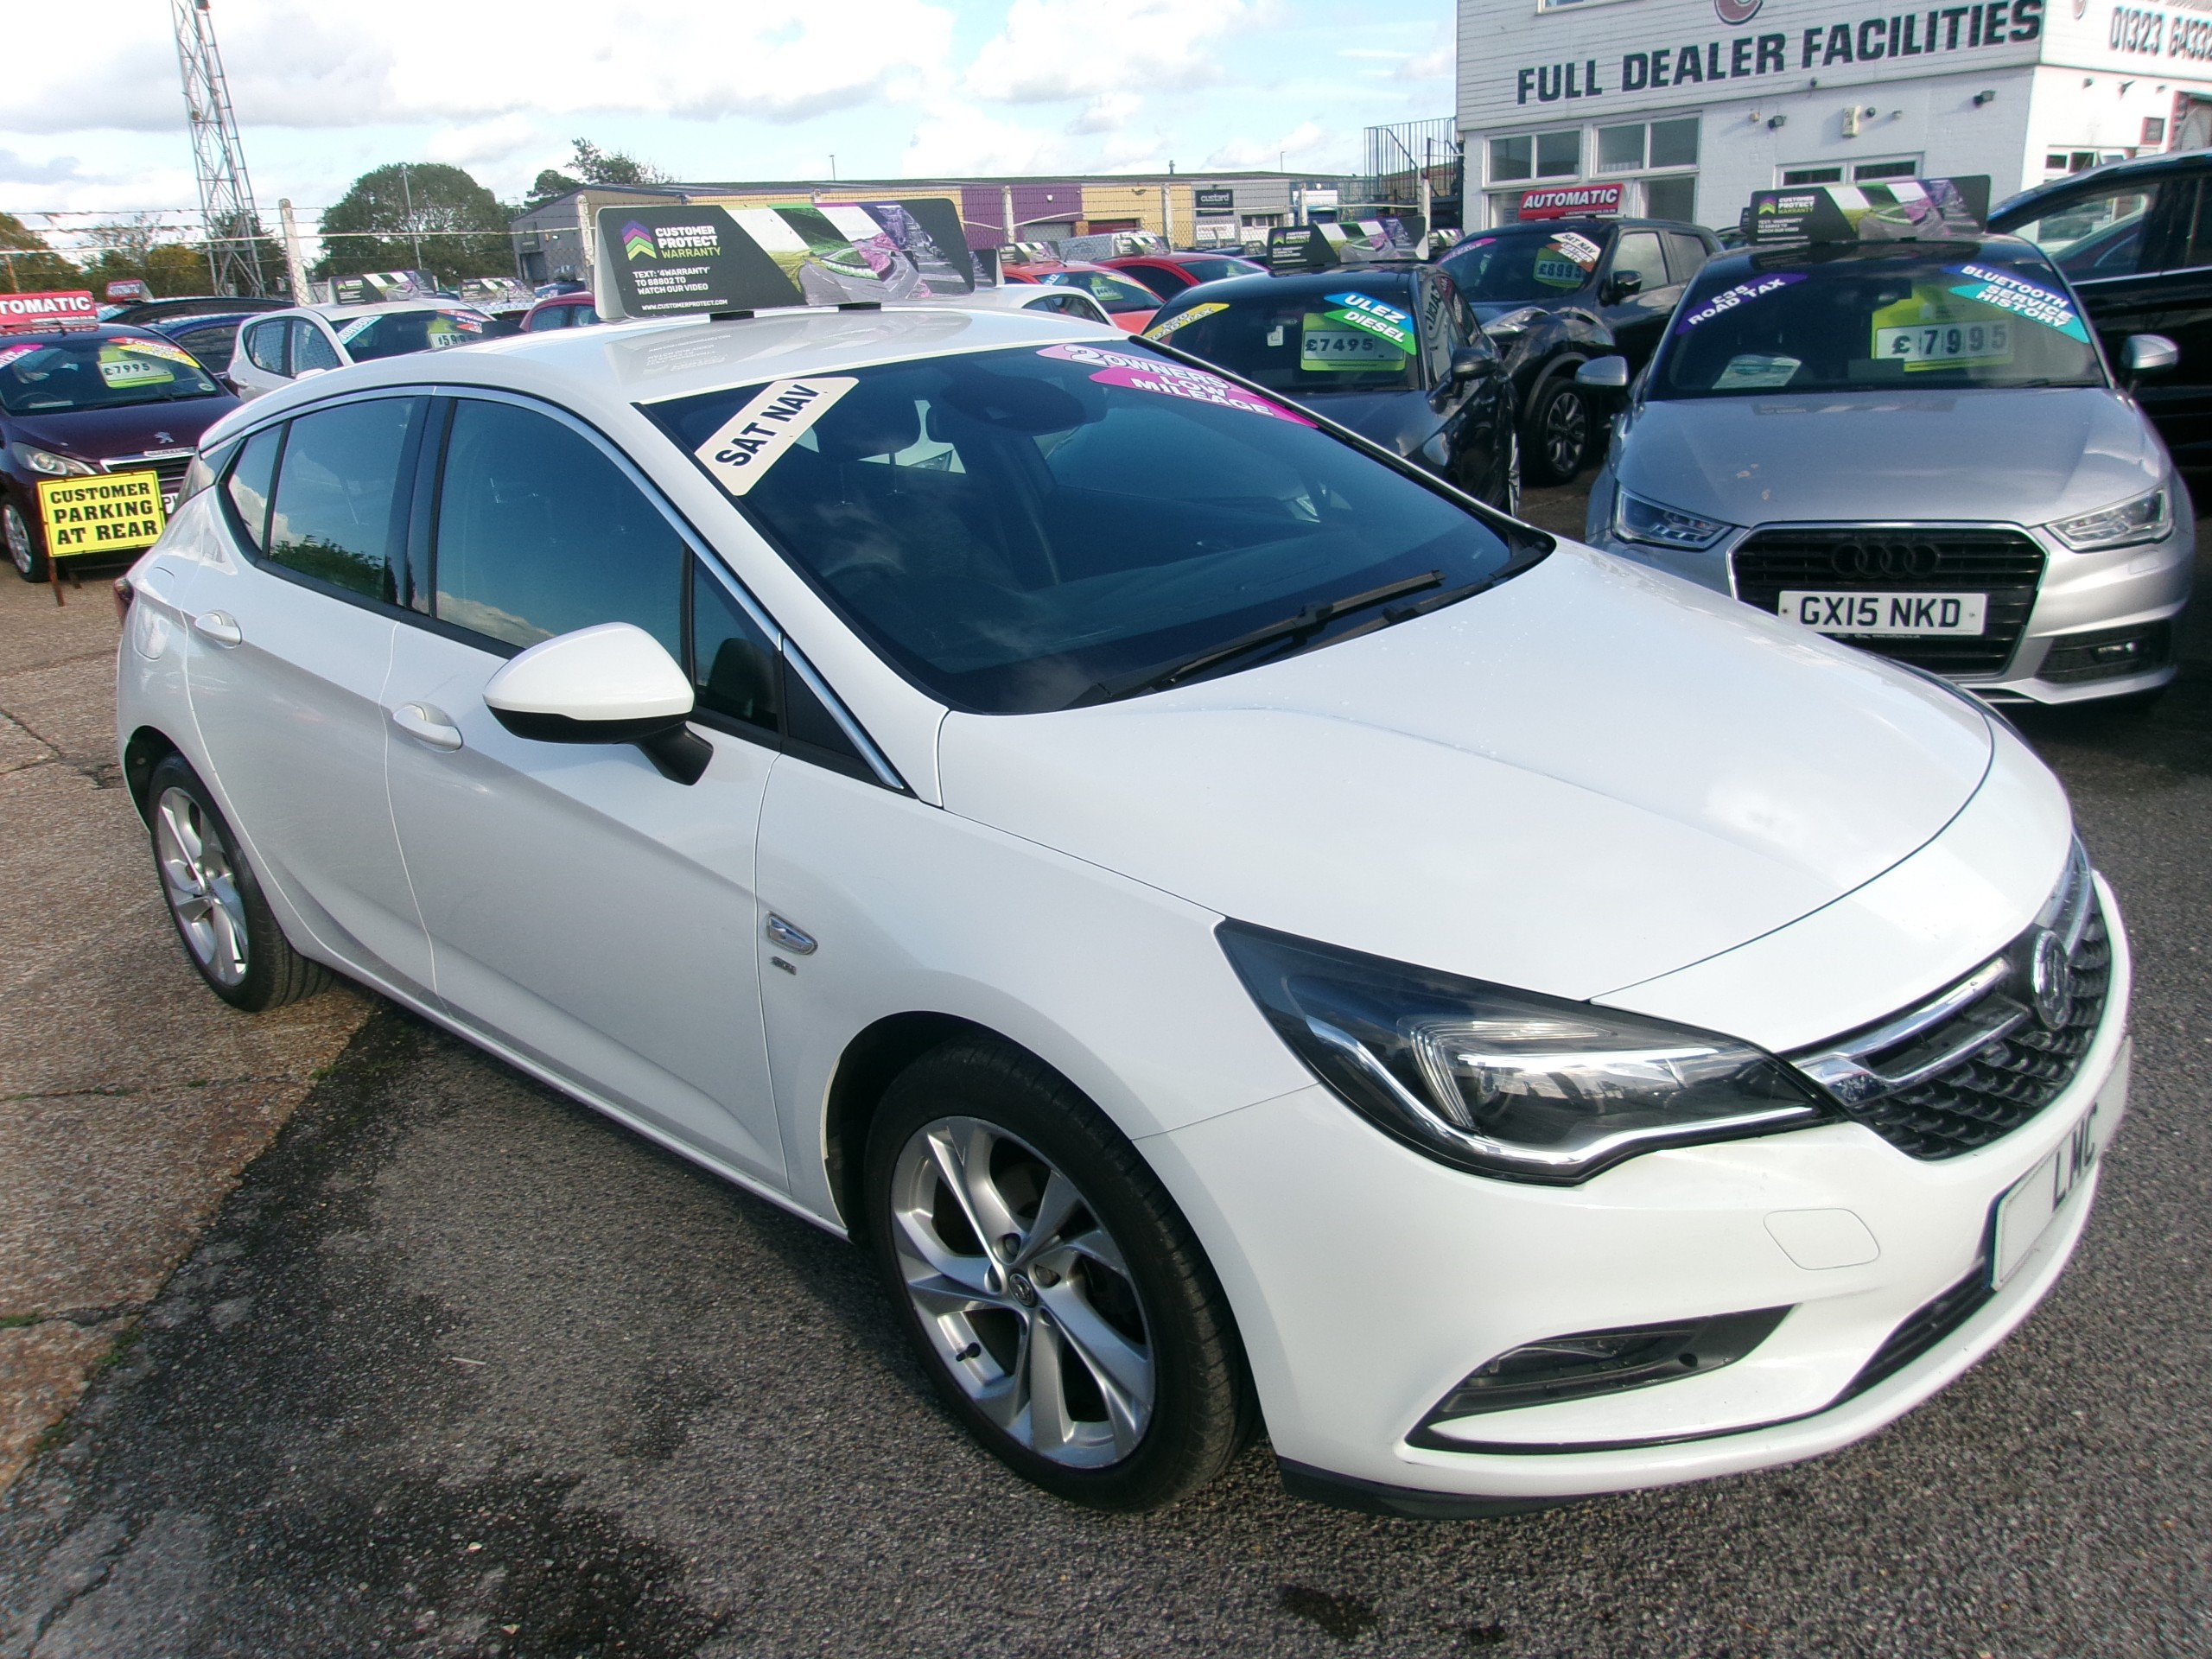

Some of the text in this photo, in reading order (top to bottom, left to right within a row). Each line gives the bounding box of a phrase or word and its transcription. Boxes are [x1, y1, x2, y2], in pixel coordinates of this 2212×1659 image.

[2109, 7, 2163, 56] 01323
[1517, 0, 2043, 105] FULL DEALER FACILITIES
[1201, 193, 1230, 202] custard
[1523, 188, 1618, 209] AUTOMATIC
[655, 226, 716, 238] CUSTOMER
[658, 236, 718, 249] PROTECT
[1561, 234, 1597, 253] SAT NAV
[661, 247, 721, 259] WARRANTY
[632, 270, 657, 279] TEXT:
[1961, 265, 2069, 308] BLUETOOTH
[637, 285, 666, 296] WATCH
[667, 284, 685, 293] OUR
[1688, 278, 1786, 325] ROAD TAX
[1986, 284, 2074, 321] SERVICE
[0, 296, 91, 315] TOMATIC
[641, 299, 728, 311] WWW.CUSTOMERPROTECT.COM
[1344, 295, 1406, 324] ULEZ
[1975, 290, 2069, 327] HISTORY
[1150, 308, 1215, 342] OAD TAX
[1344, 311, 1404, 343] DIESEL
[1306, 338, 1374, 352] £7495
[1891, 324, 2007, 355] £7995
[103, 363, 150, 376] £7995
[1129, 378, 1274, 416] MILEAGE
[1160, 374, 1226, 397] LOW
[715, 384, 820, 467] SAT NAV
[50, 482, 150, 505] CUSTOMER
[54, 499, 154, 524] PARKING
[57, 520, 158, 545] AT REAR
[1800, 596, 1961, 627] GX15 NKD
